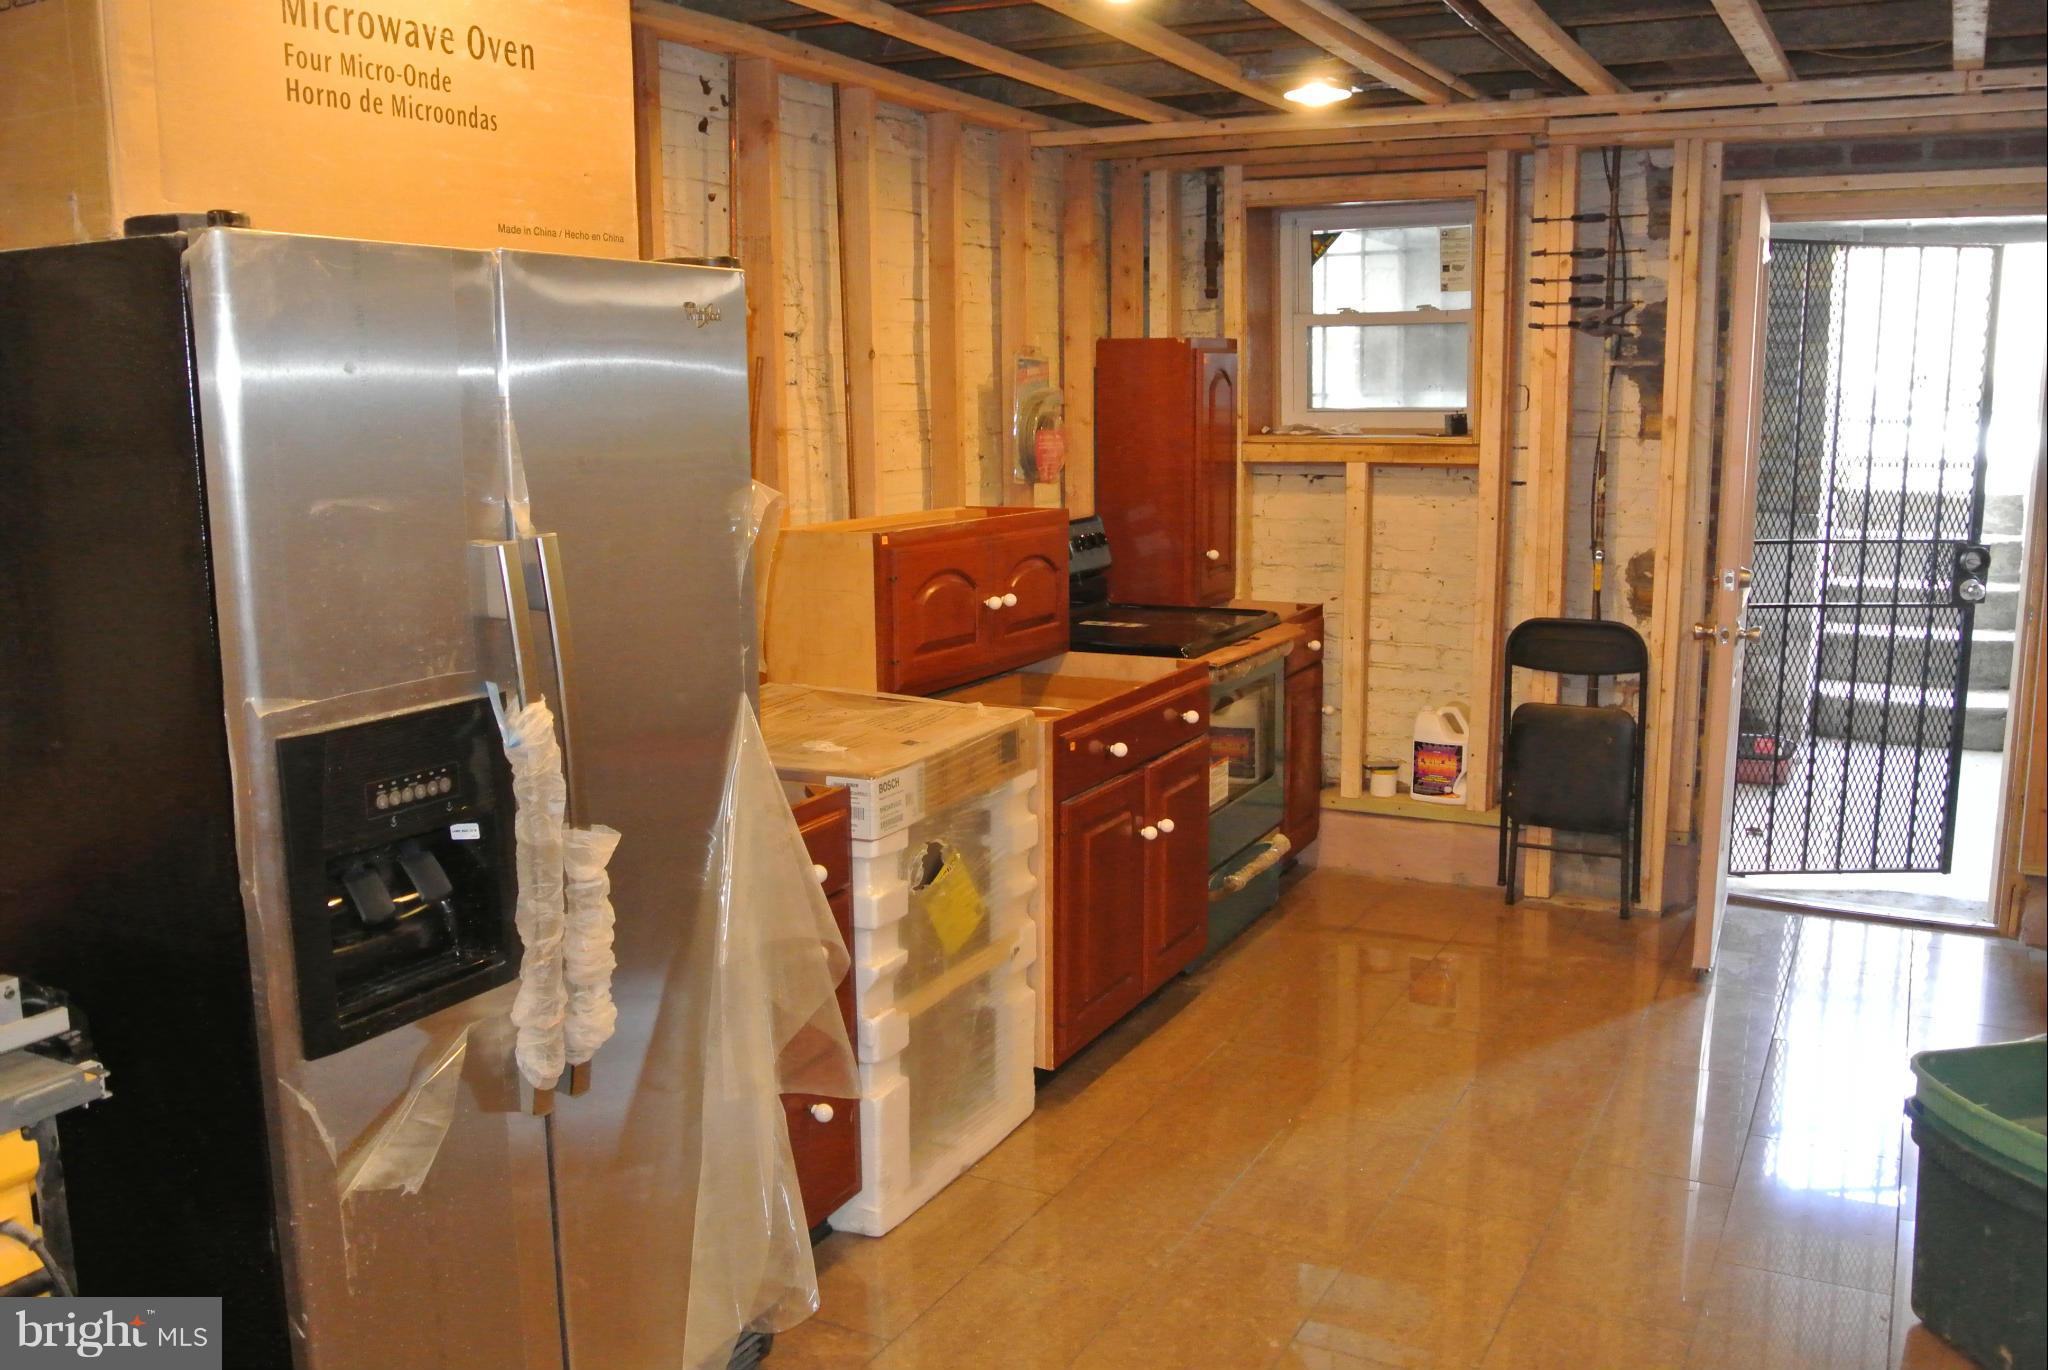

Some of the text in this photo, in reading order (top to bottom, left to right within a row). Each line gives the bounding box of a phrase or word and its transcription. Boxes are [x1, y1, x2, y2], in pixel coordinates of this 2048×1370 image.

[281, 0, 535, 71] Microwave Oven
[283, 42, 453, 93] Four Micro-Onde
[285, 77, 498, 132] Horno de Microondas
[497, 223, 521, 234] Made
[523, 226, 532, 236] in
[533, 226, 557, 238] China
[564, 230, 590, 240] Hecho
[591, 233, 601, 241] en
[602, 232, 625, 243] China
[878, 777, 900, 794] BOSCH
